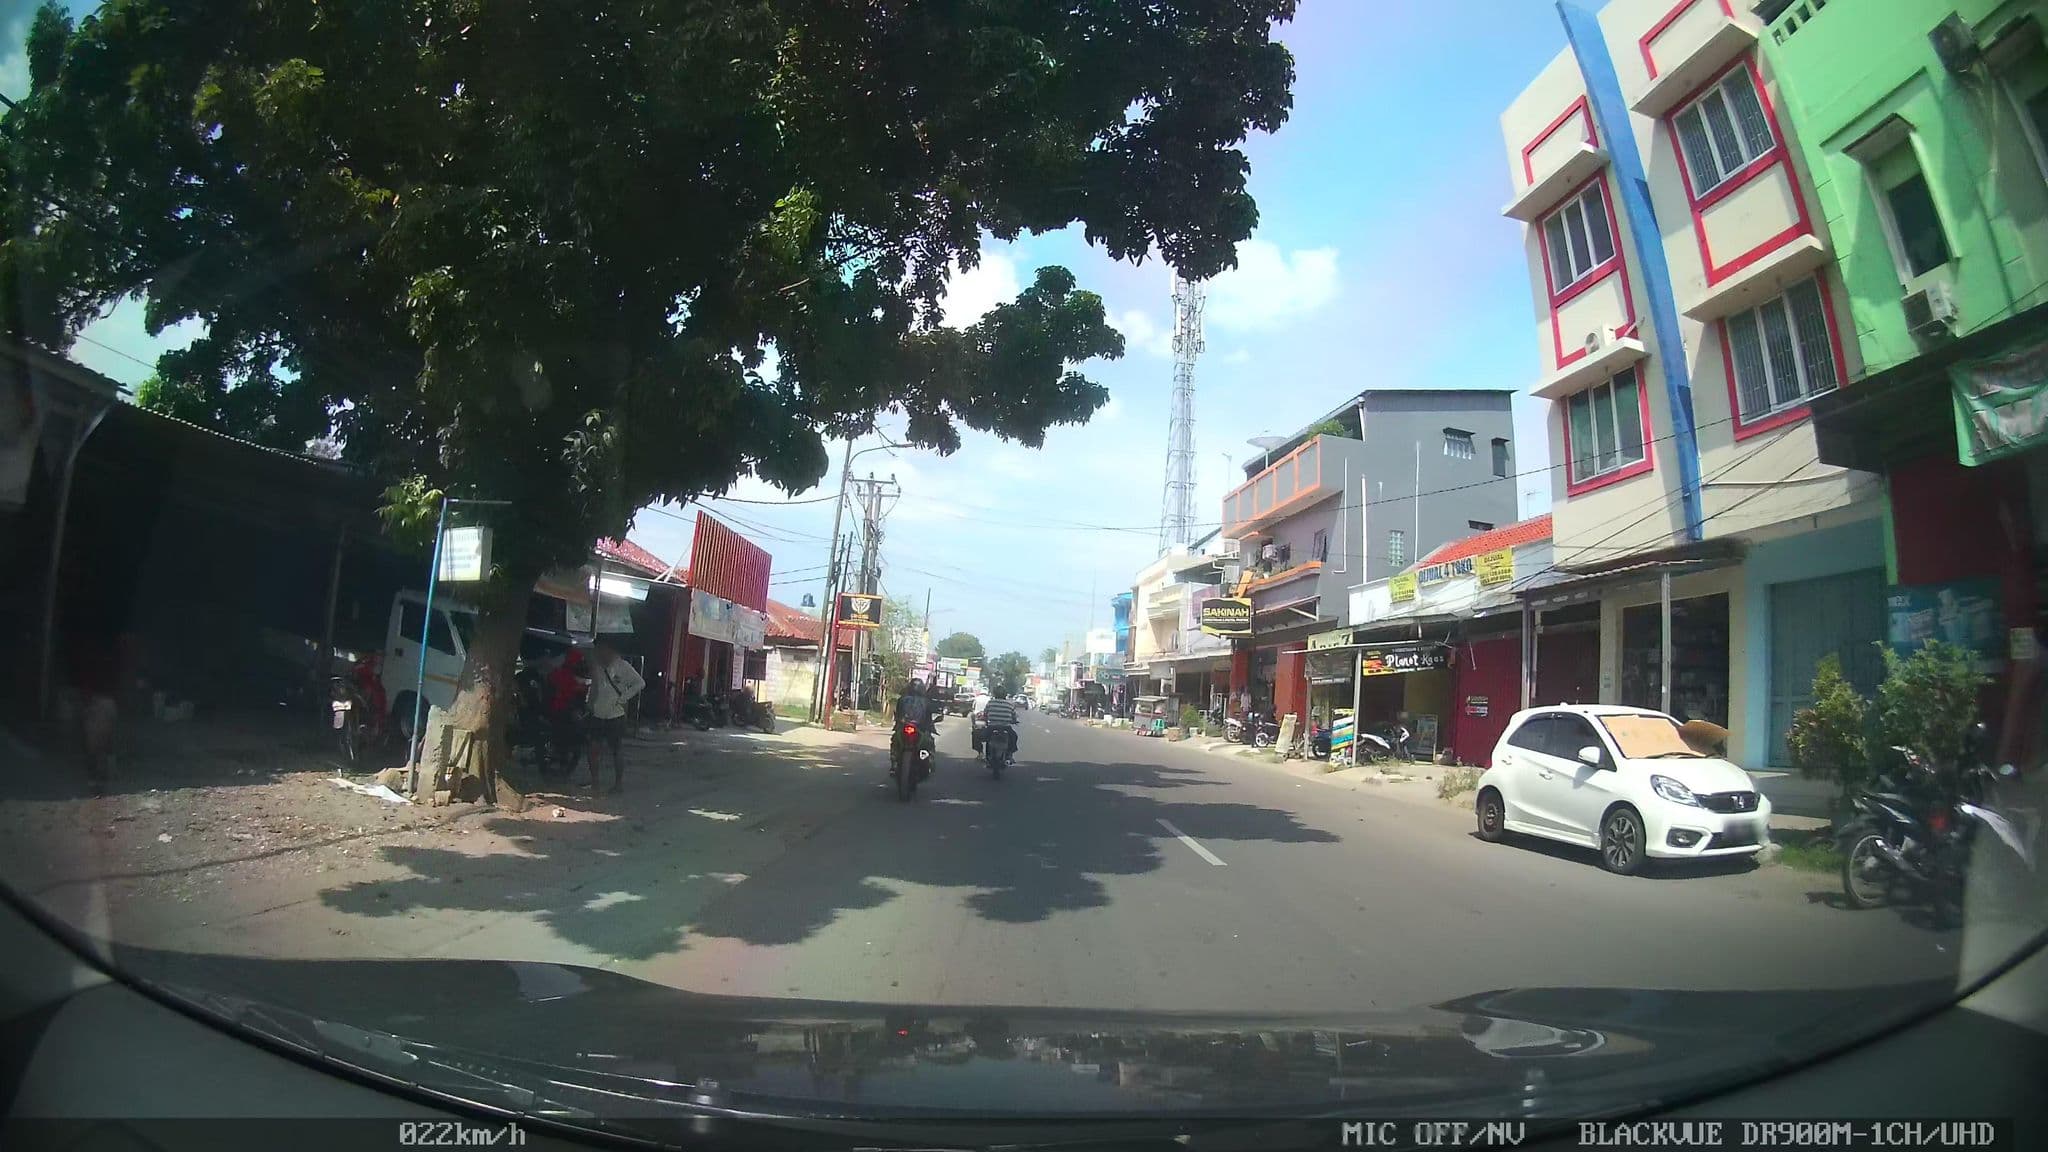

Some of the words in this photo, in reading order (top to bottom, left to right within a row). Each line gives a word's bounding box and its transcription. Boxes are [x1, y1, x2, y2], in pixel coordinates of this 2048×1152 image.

[1451, 557, 1472, 576] TOKO
[1203, 607, 1249, 617] SAKINAH
[1385, 653, 1419, 668] Planet
